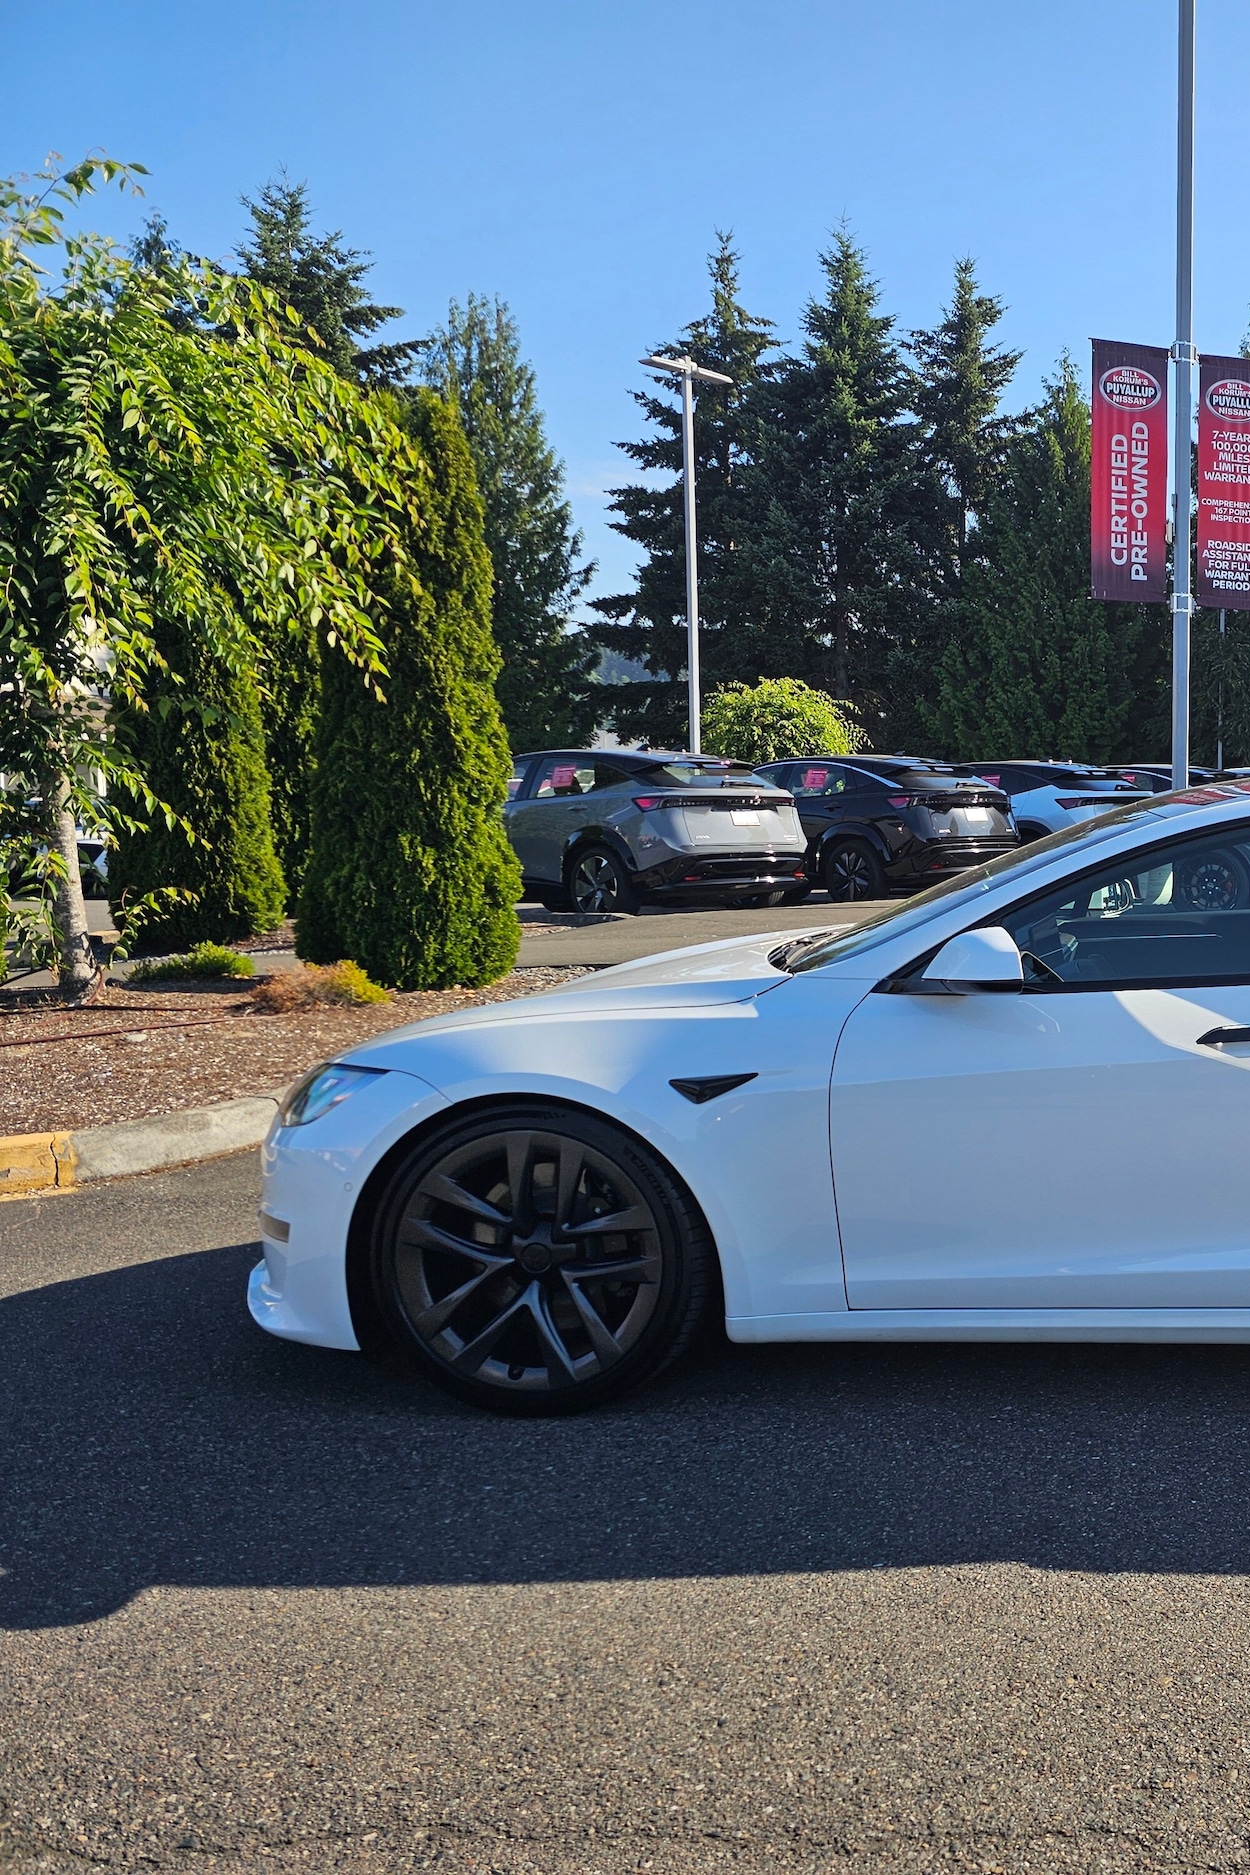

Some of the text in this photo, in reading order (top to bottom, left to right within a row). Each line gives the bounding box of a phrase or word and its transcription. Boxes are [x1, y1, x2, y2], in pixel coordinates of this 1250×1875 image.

[1121, 370, 1139, 378] BILL
[1113, 375, 1149, 386] KORUM'S
[1106, 382, 1155, 398] PUYALLUP
[1226, 382, 1243, 391] BILL
[1112, 394, 1146, 405] NISSAN
[1218, 407, 1250, 417] NISSAN
[1218, 452, 1250, 463] MILES
[1110, 433, 1128, 567] CERTIFIED
[1130, 421, 1149, 581] PRE-OWNED
[1208, 559, 1229, 570] FOR
[1212, 580, 1250, 591] PERIOD
